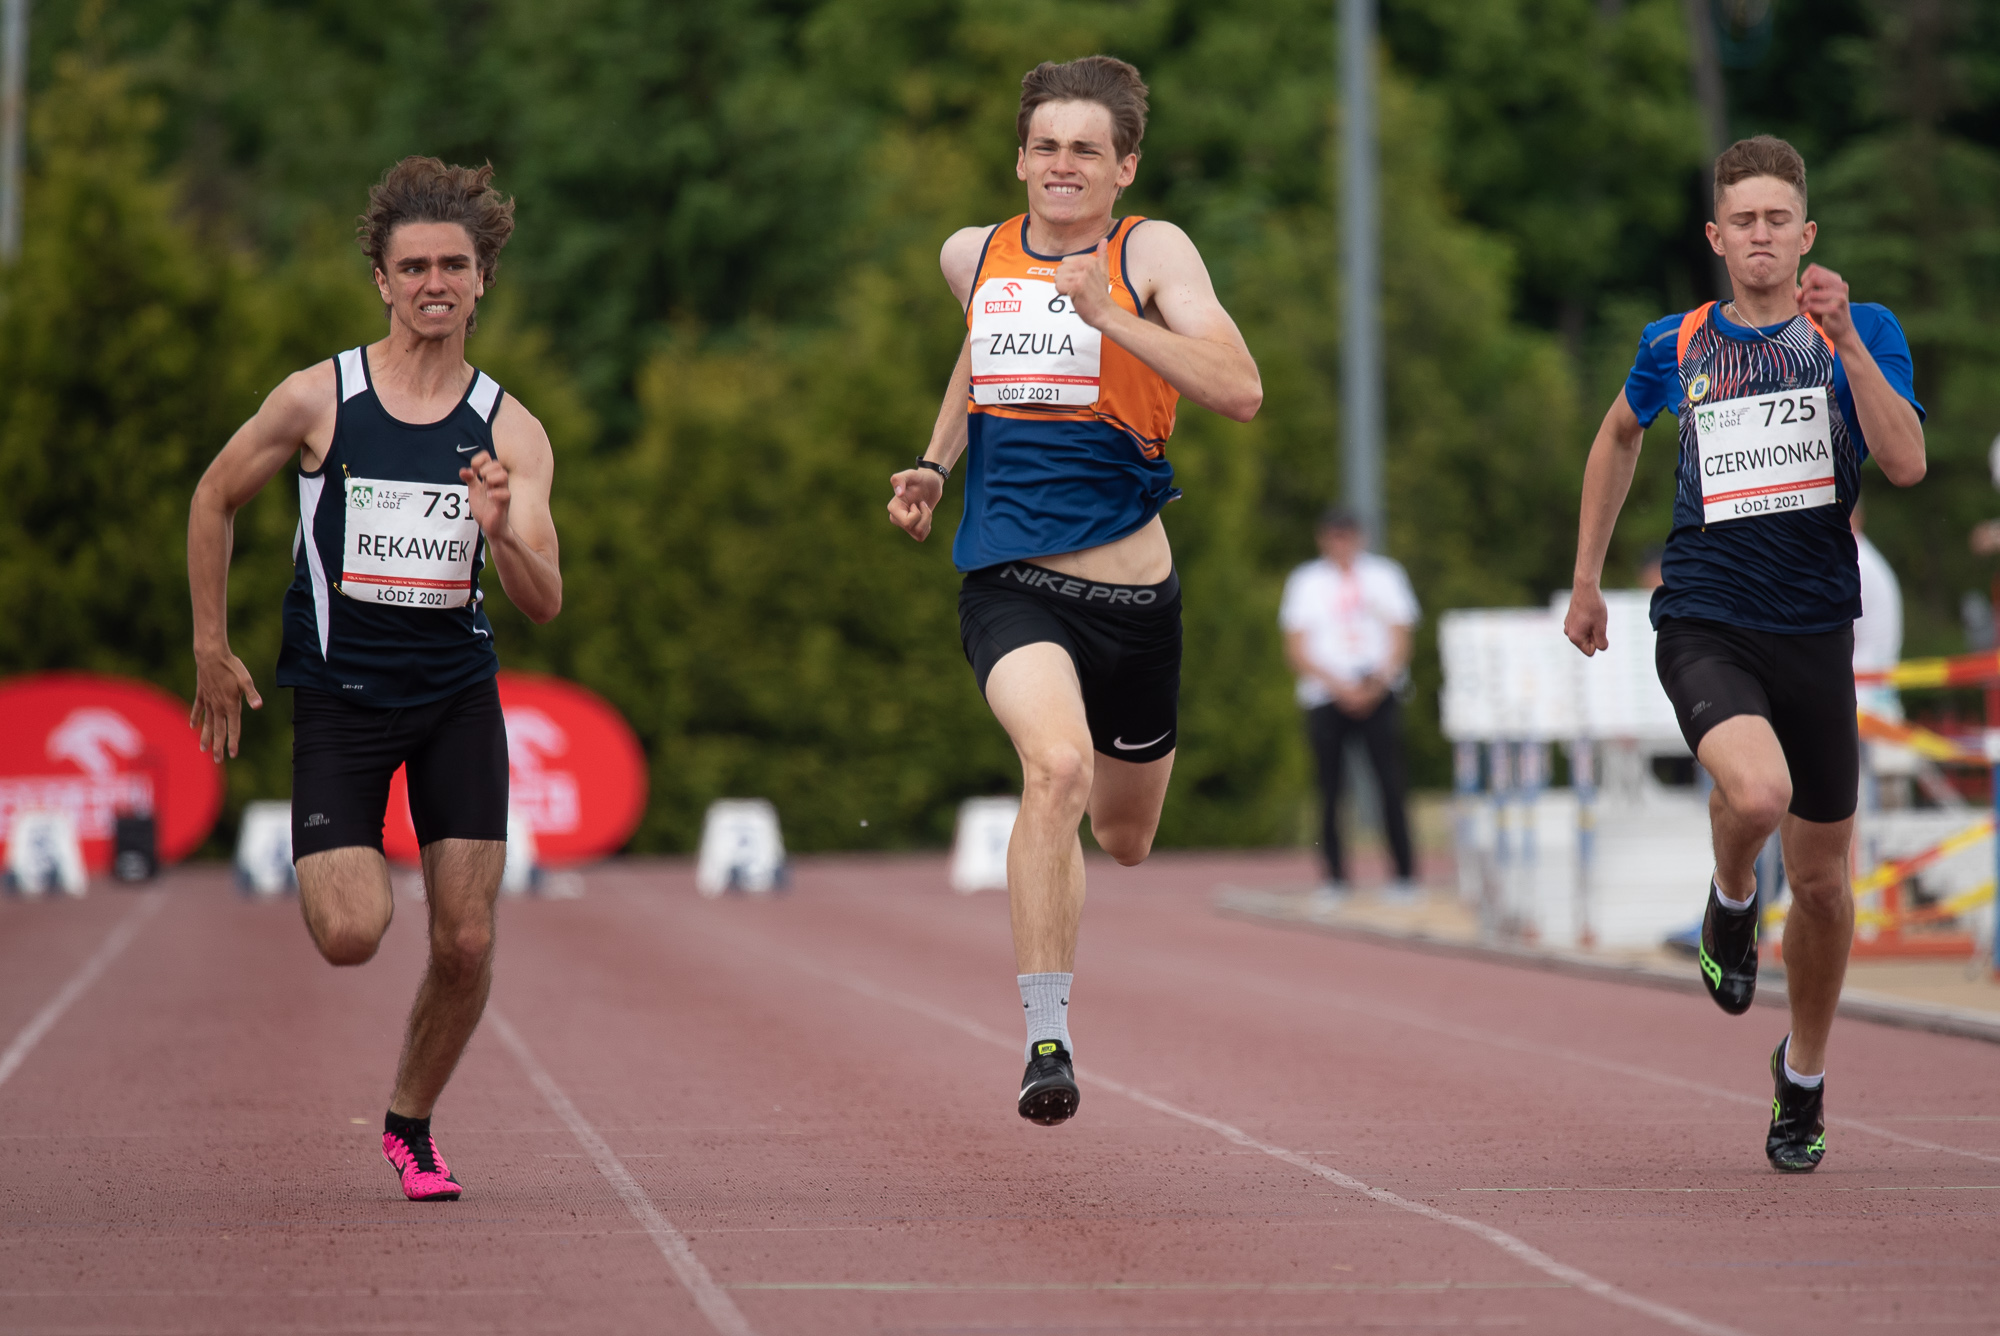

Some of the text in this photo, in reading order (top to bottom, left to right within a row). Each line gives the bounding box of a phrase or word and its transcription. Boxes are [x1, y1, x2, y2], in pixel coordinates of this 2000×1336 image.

[1026, 266, 1057, 277] COL
[986, 302, 1019, 313] ORLEN
[1048, 294, 1076, 314] 6
[989, 333, 1075, 356] ZAZULA
[997, 384, 1060, 401] ŁÓDŹ 2021
[1759, 395, 1816, 427] 725
[1704, 439, 1829, 477] CZERWIONKA
[377, 490, 397, 500] AZS
[1734, 495, 1771, 515] ŁÓDŹ
[1774, 494, 1806, 509] 2021
[358, 533, 470, 561] RĘKAWEK
[1000, 564, 1157, 605] NIKE PRO
[376, 586, 448, 605] ŁÓDŹ 2021
